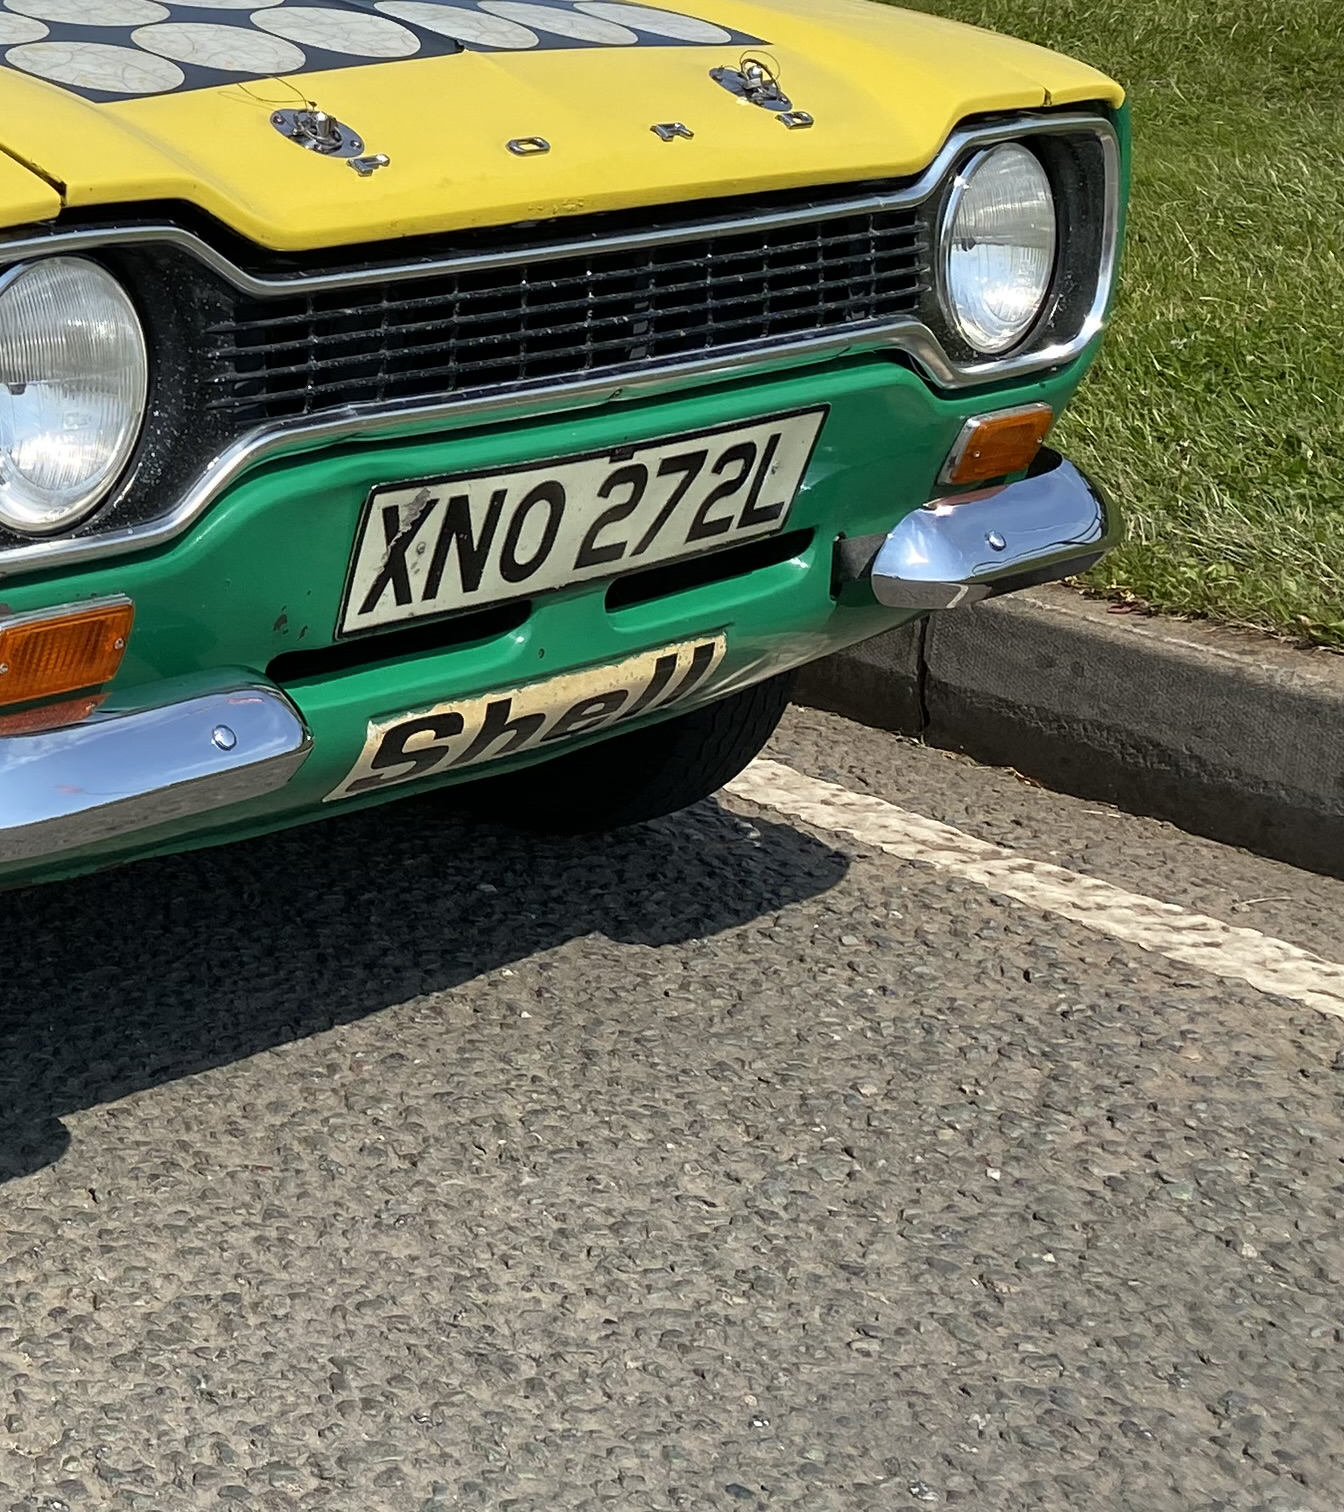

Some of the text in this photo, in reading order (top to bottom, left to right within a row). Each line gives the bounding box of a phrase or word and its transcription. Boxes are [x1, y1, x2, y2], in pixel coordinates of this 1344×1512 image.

[357, 432, 785, 616] XNO 272L
[344, 641, 716, 794] Shell
